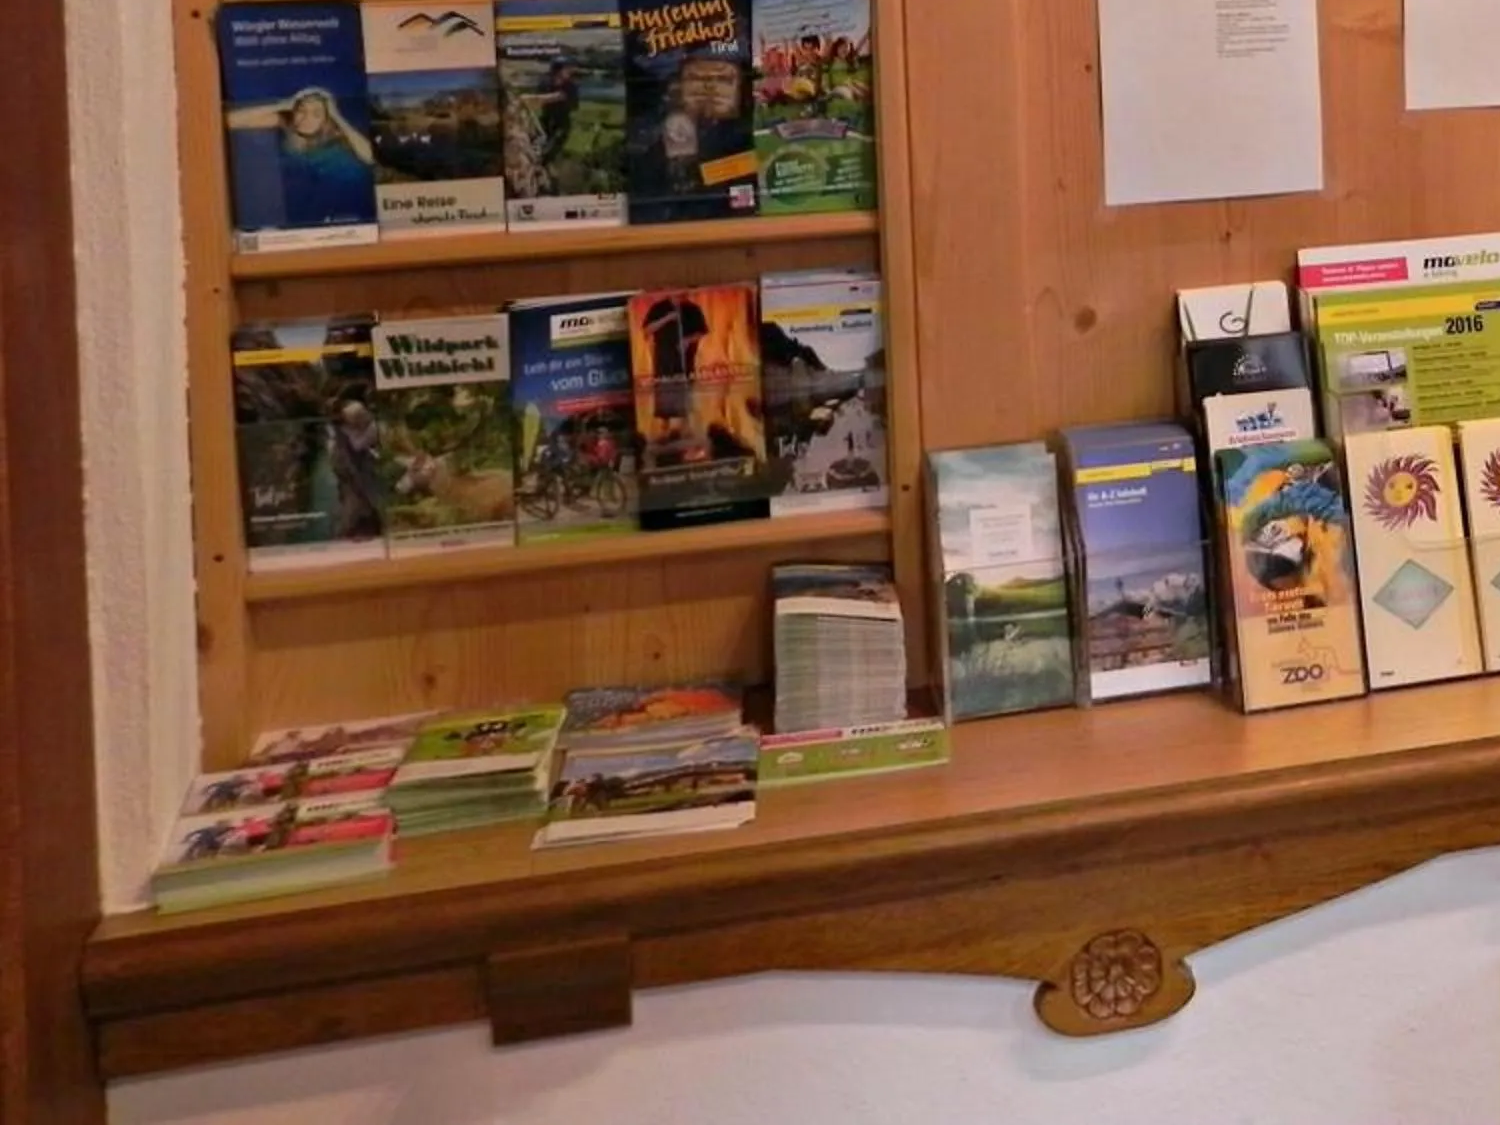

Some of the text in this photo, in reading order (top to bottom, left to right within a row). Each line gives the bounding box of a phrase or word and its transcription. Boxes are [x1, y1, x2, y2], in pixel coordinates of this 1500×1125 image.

[646, 16, 736, 57] friedhof
[1423, 248, 1500, 269] movelo
[1445, 314, 1484, 335] 2016
[386, 334, 499, 356] Wildpark
[551, 375, 584, 390] vom
[1279, 663, 1323, 684] ZOO
